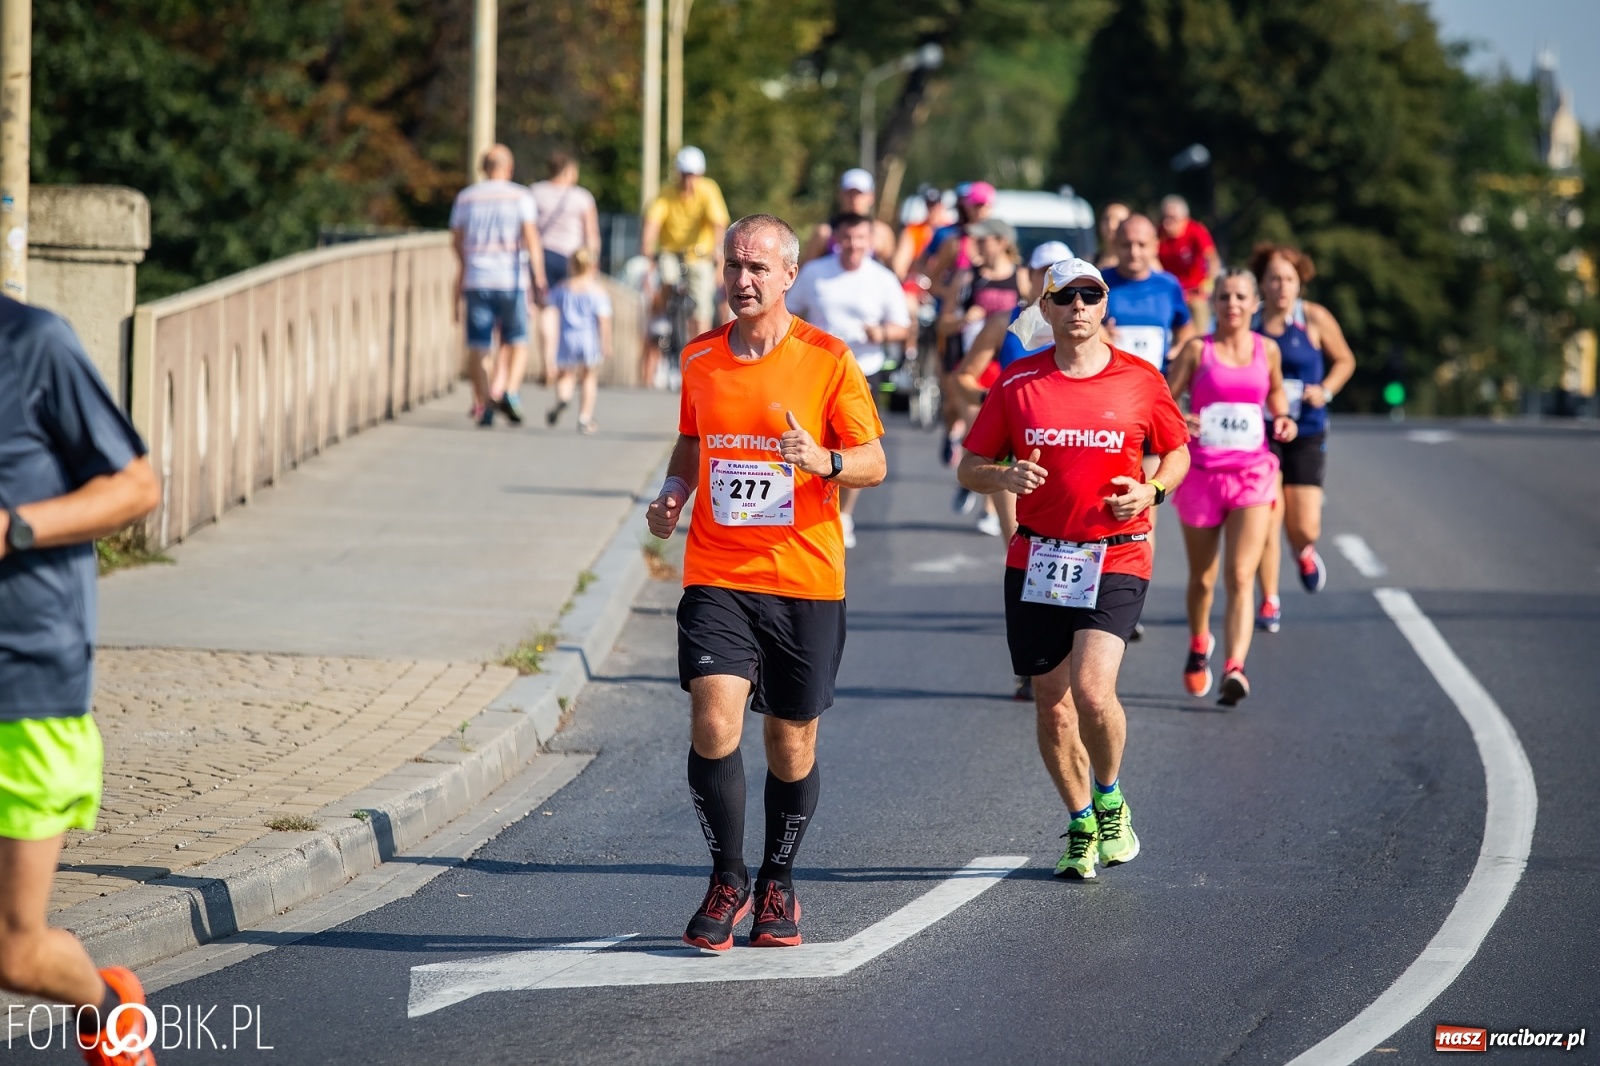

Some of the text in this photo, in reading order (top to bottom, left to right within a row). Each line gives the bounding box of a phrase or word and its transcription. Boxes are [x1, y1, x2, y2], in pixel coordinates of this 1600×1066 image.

[706, 434, 781, 452] DECATHLO
[1025, 428, 1125, 449] DECATHLON
[730, 479, 771, 500] 277
[1046, 561, 1083, 583] 213
[771, 812, 806, 865] kalenji
